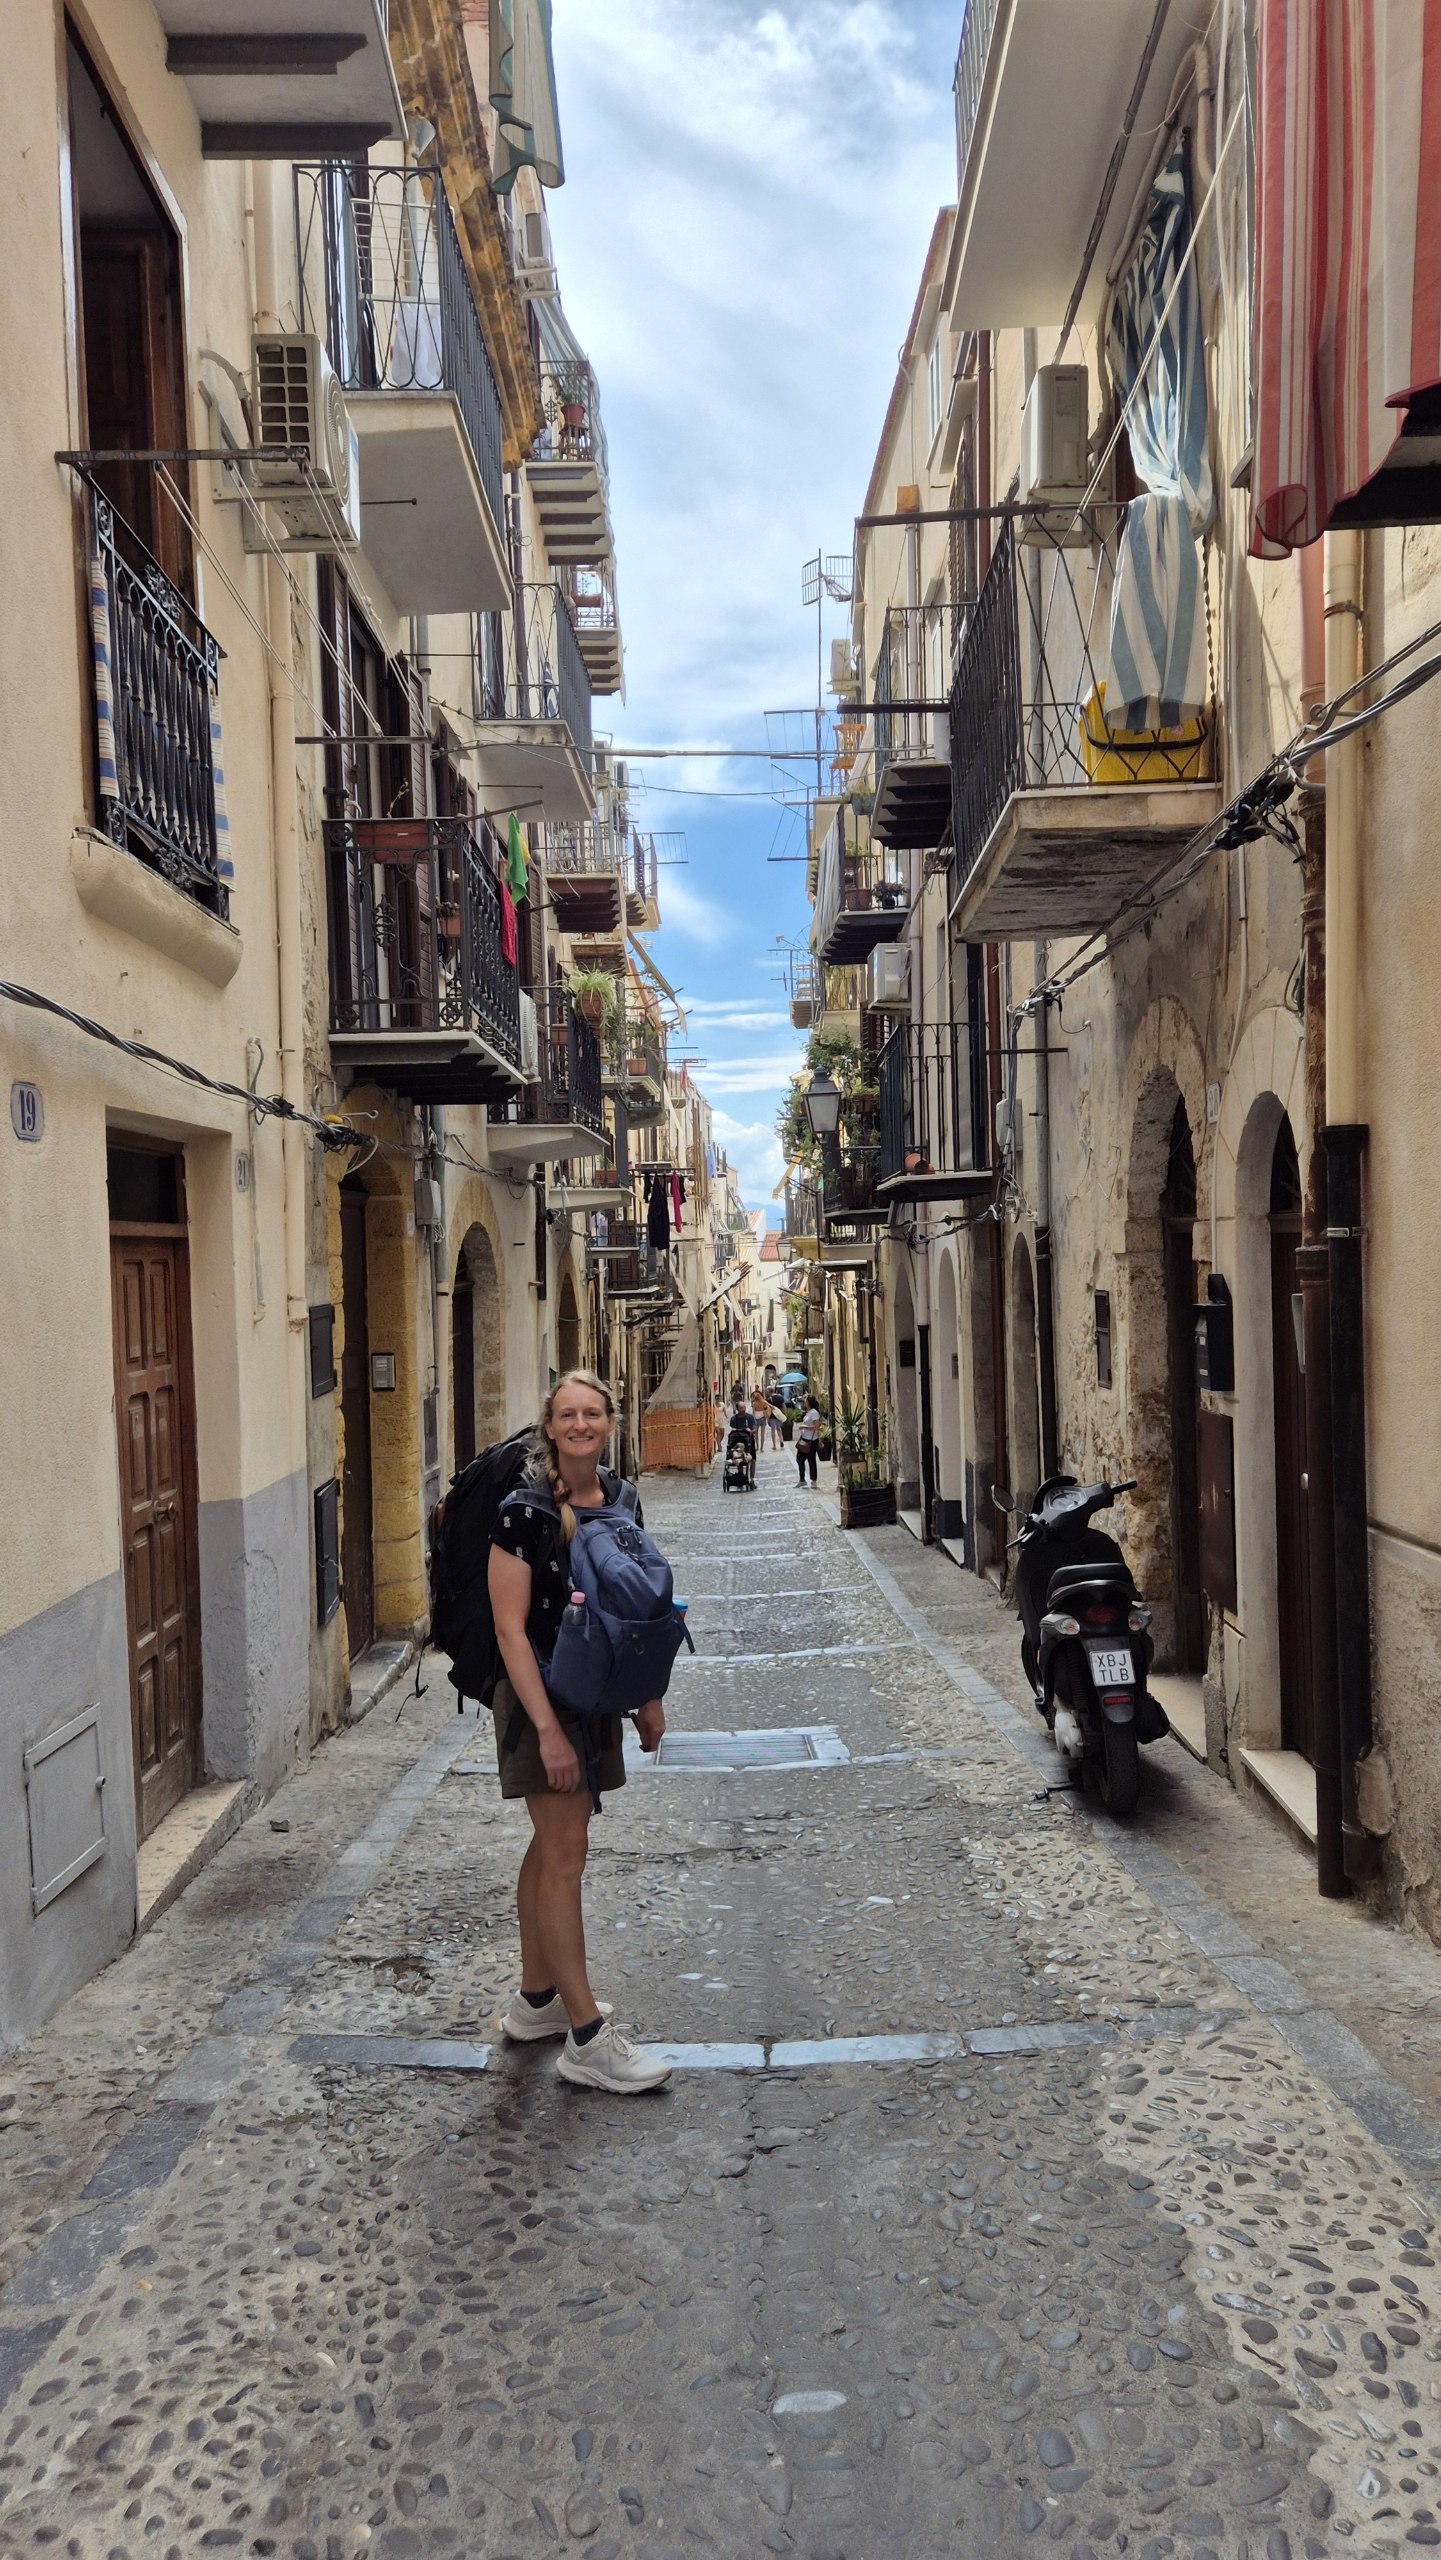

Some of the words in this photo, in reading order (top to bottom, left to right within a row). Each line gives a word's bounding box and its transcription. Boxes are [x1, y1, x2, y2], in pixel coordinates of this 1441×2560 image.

[19, 1090, 36, 1132] 19
[238, 1158, 246, 1187] 21
[1097, 1653, 1127, 1668] XBJ
[1099, 1668, 1129, 1683] TLB
